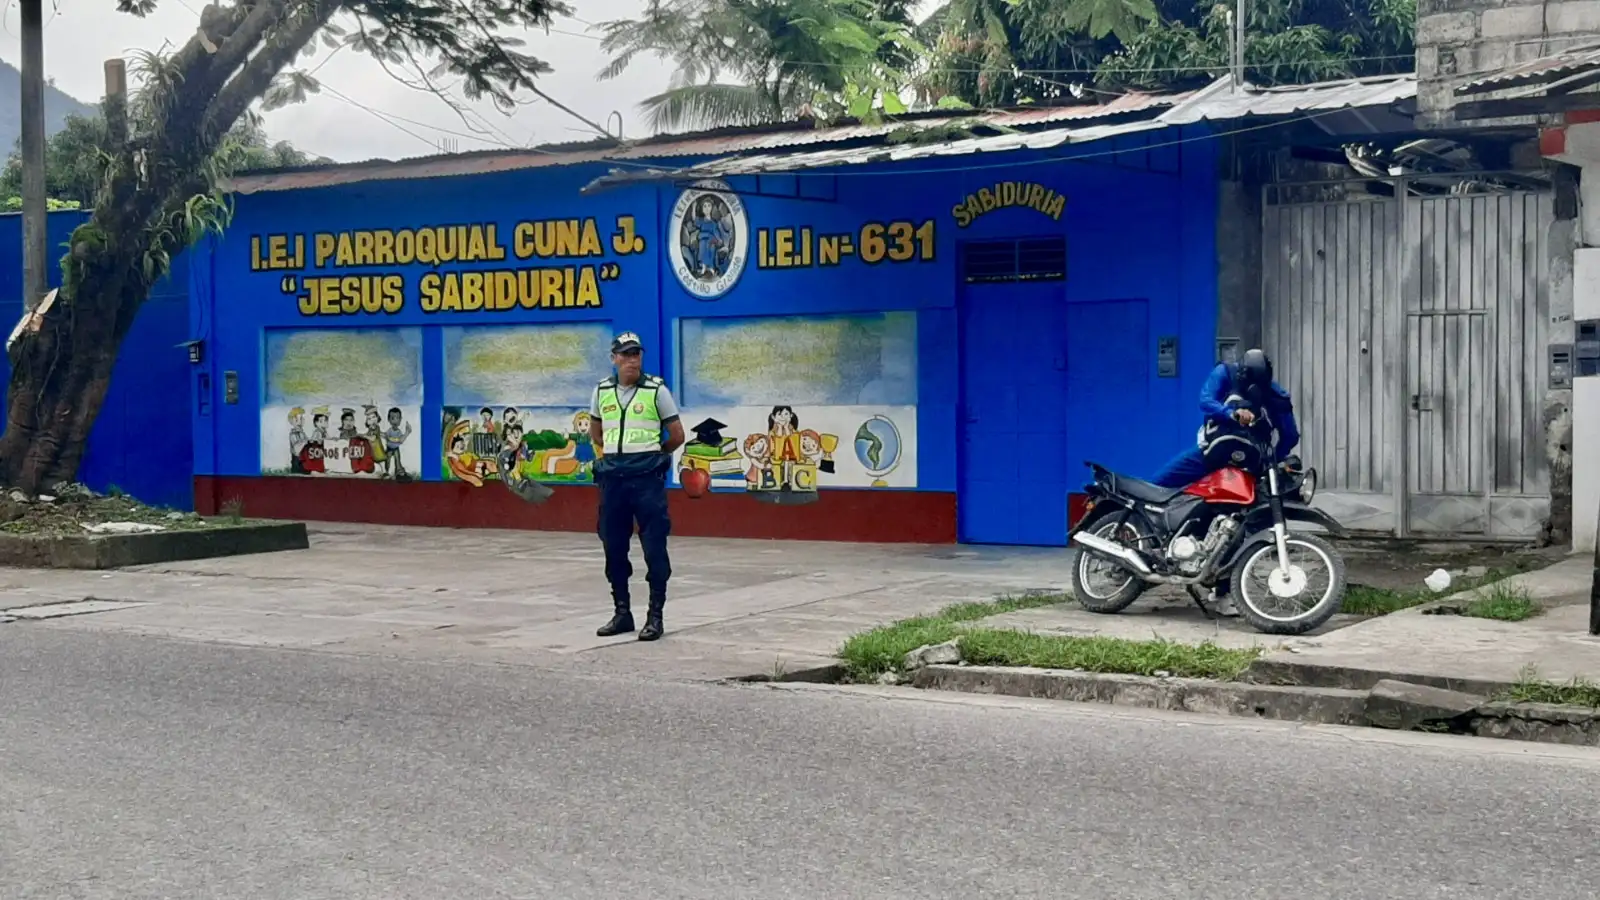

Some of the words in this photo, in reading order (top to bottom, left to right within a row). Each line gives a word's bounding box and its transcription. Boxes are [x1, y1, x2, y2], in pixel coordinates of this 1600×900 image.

[951, 180, 1066, 228] SABIDURIA
[249, 234, 305, 271] I.E.I
[314, 224, 504, 268] PARROQUIAL
[513, 217, 602, 259] CUNA
[612, 214, 645, 255] J.
[757, 227, 812, 269] I.E.I
[859, 219, 936, 263] 631
[761, 468, 777, 489] B
[795, 469, 811, 490] C
